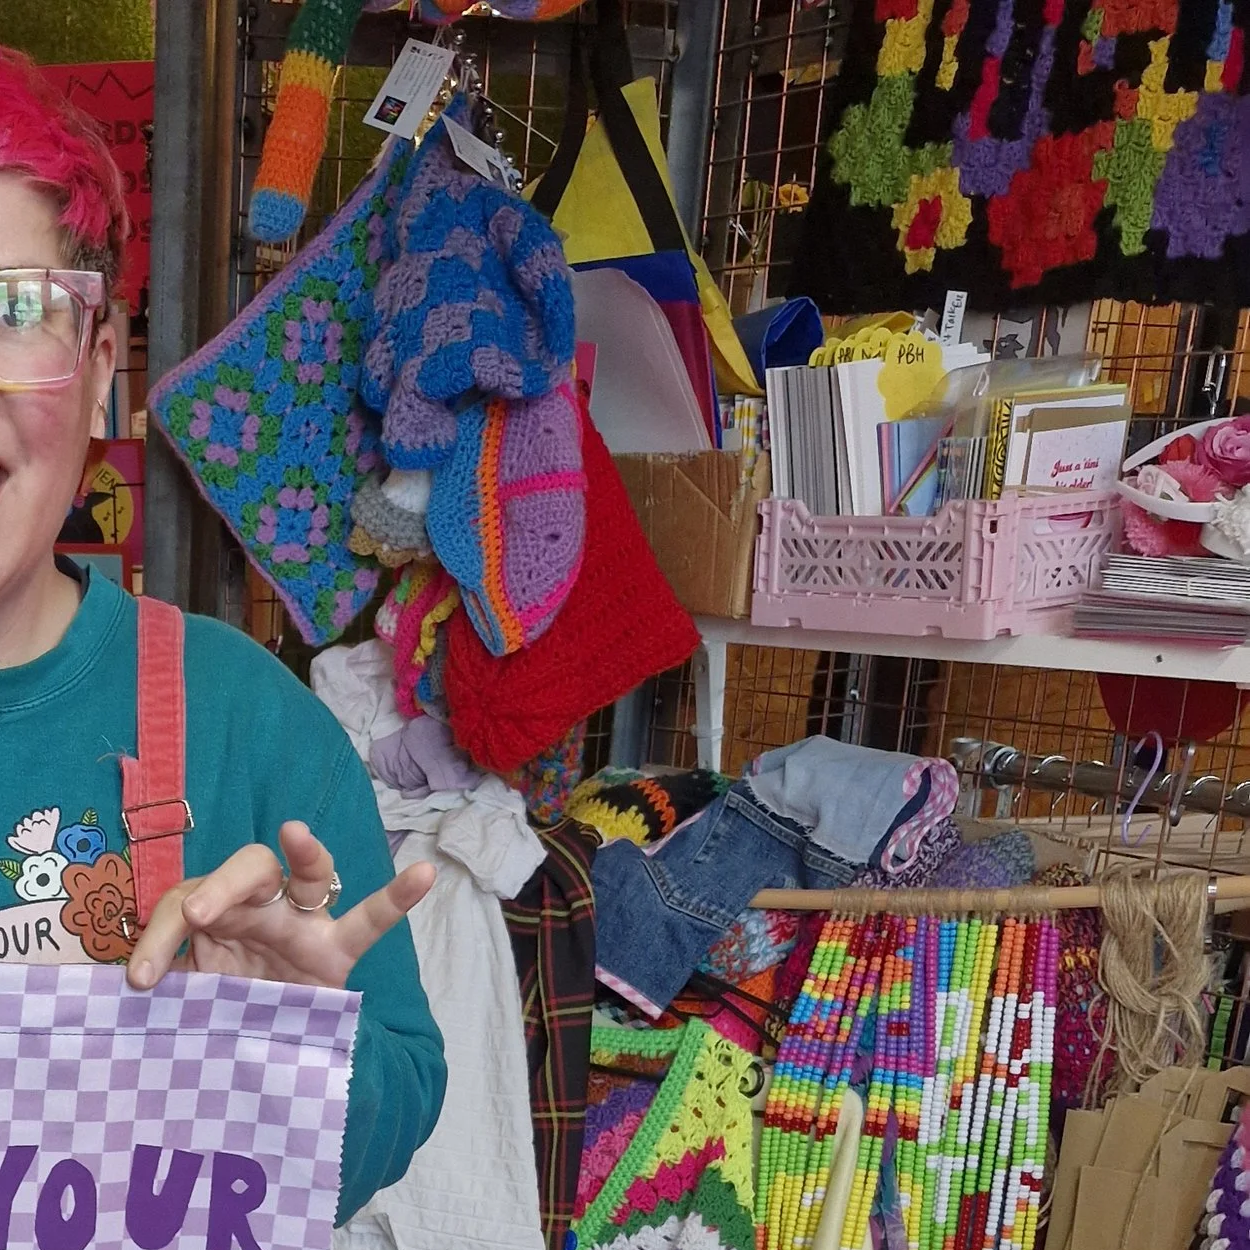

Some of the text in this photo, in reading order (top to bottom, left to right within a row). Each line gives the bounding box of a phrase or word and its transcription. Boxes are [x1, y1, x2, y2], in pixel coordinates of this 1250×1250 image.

[897, 342, 925, 365] PBH
[1050, 458, 1072, 478] Just
[1073, 463, 1081, 471] a
